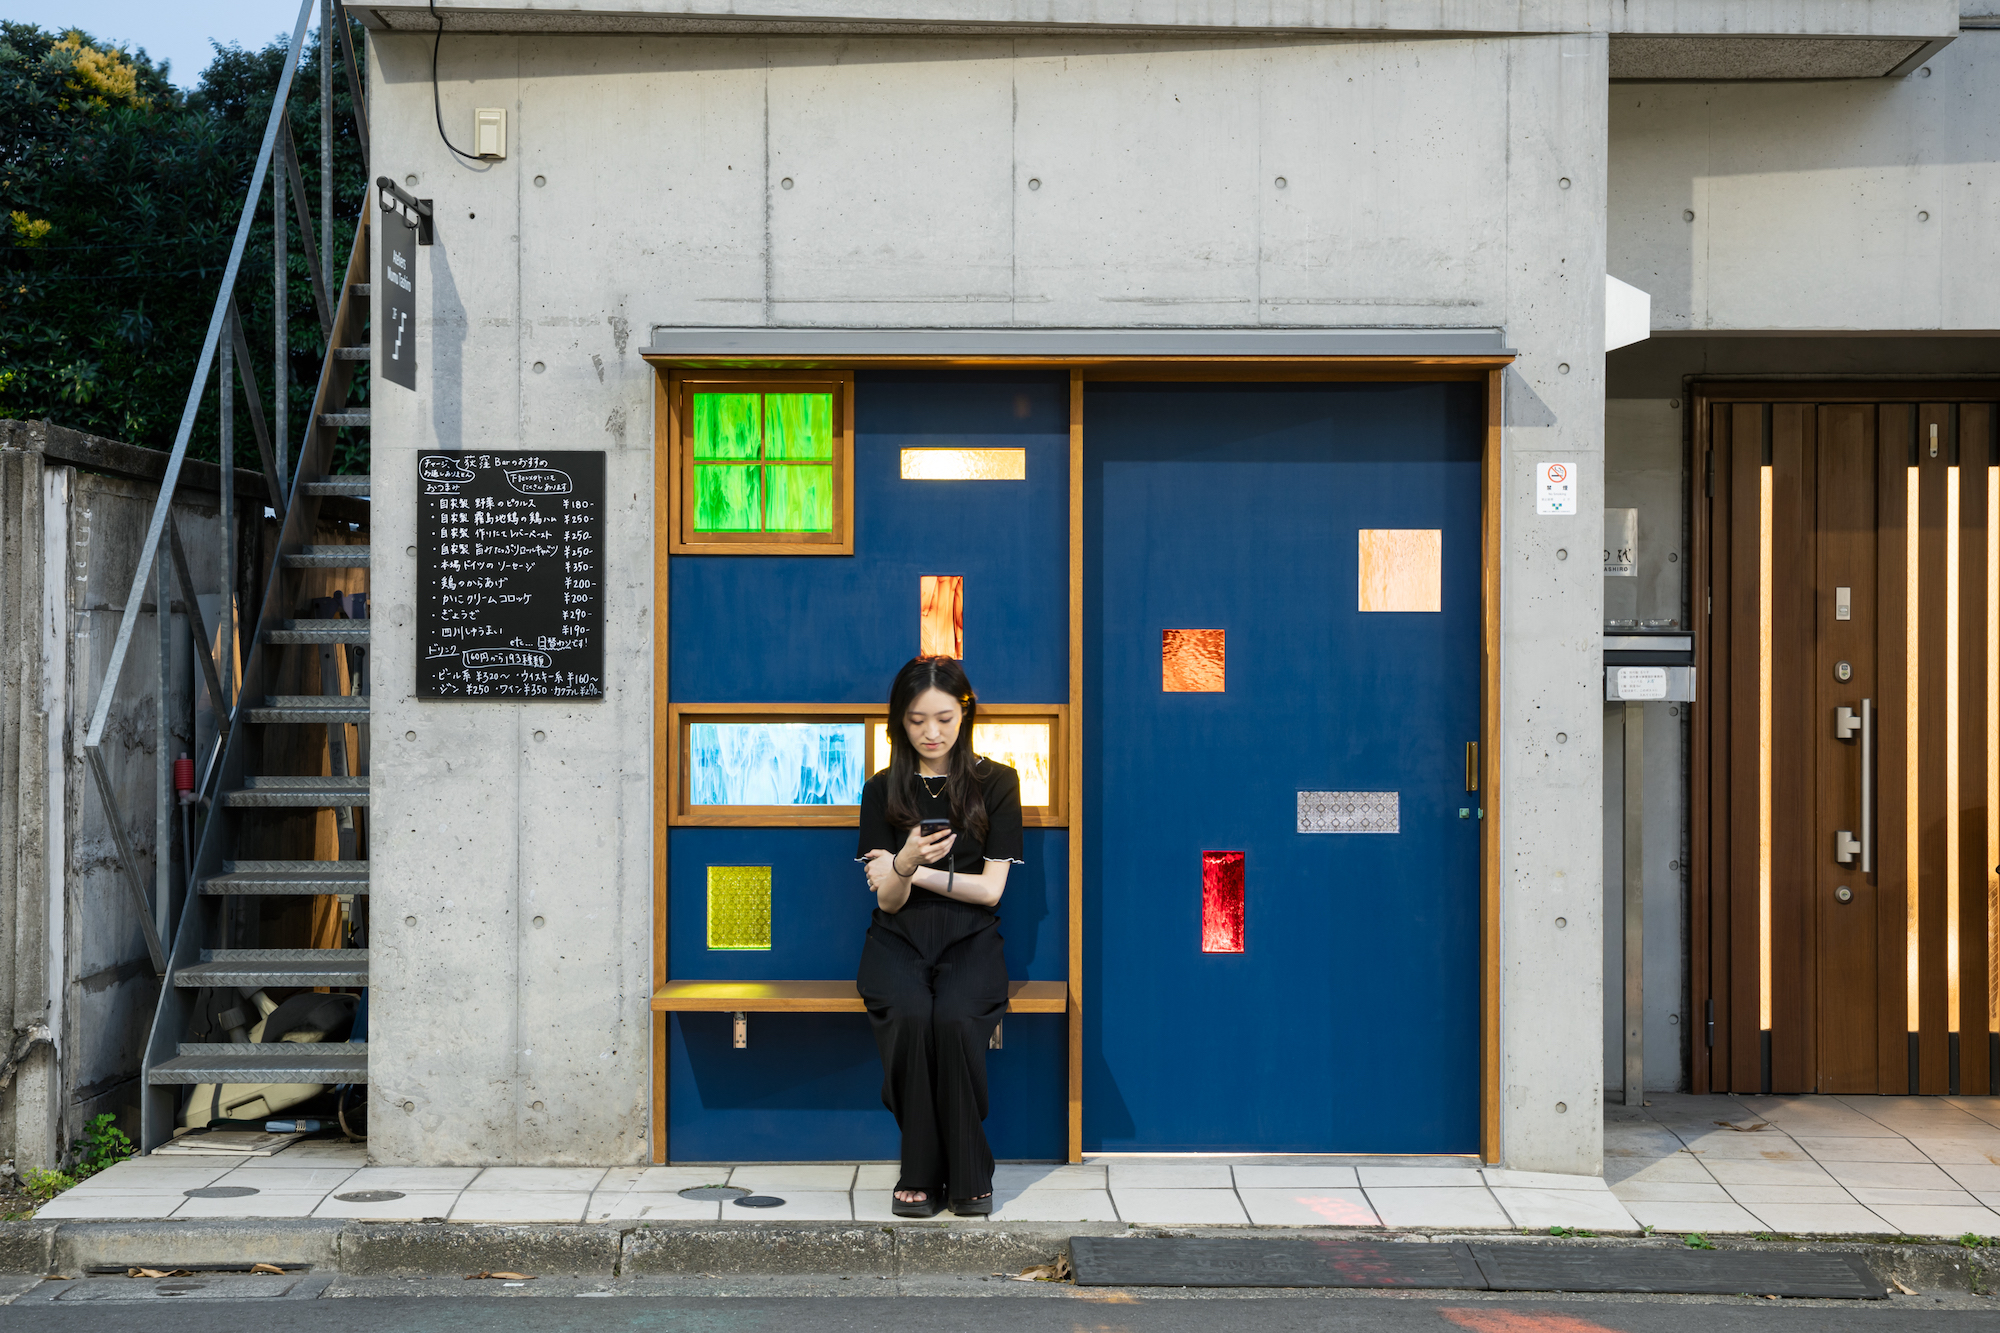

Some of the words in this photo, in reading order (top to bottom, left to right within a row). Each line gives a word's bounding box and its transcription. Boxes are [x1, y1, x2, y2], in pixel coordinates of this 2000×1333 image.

[440, 608, 481, 621] ぎょうざ
[428, 643, 457, 656] ドリンク
